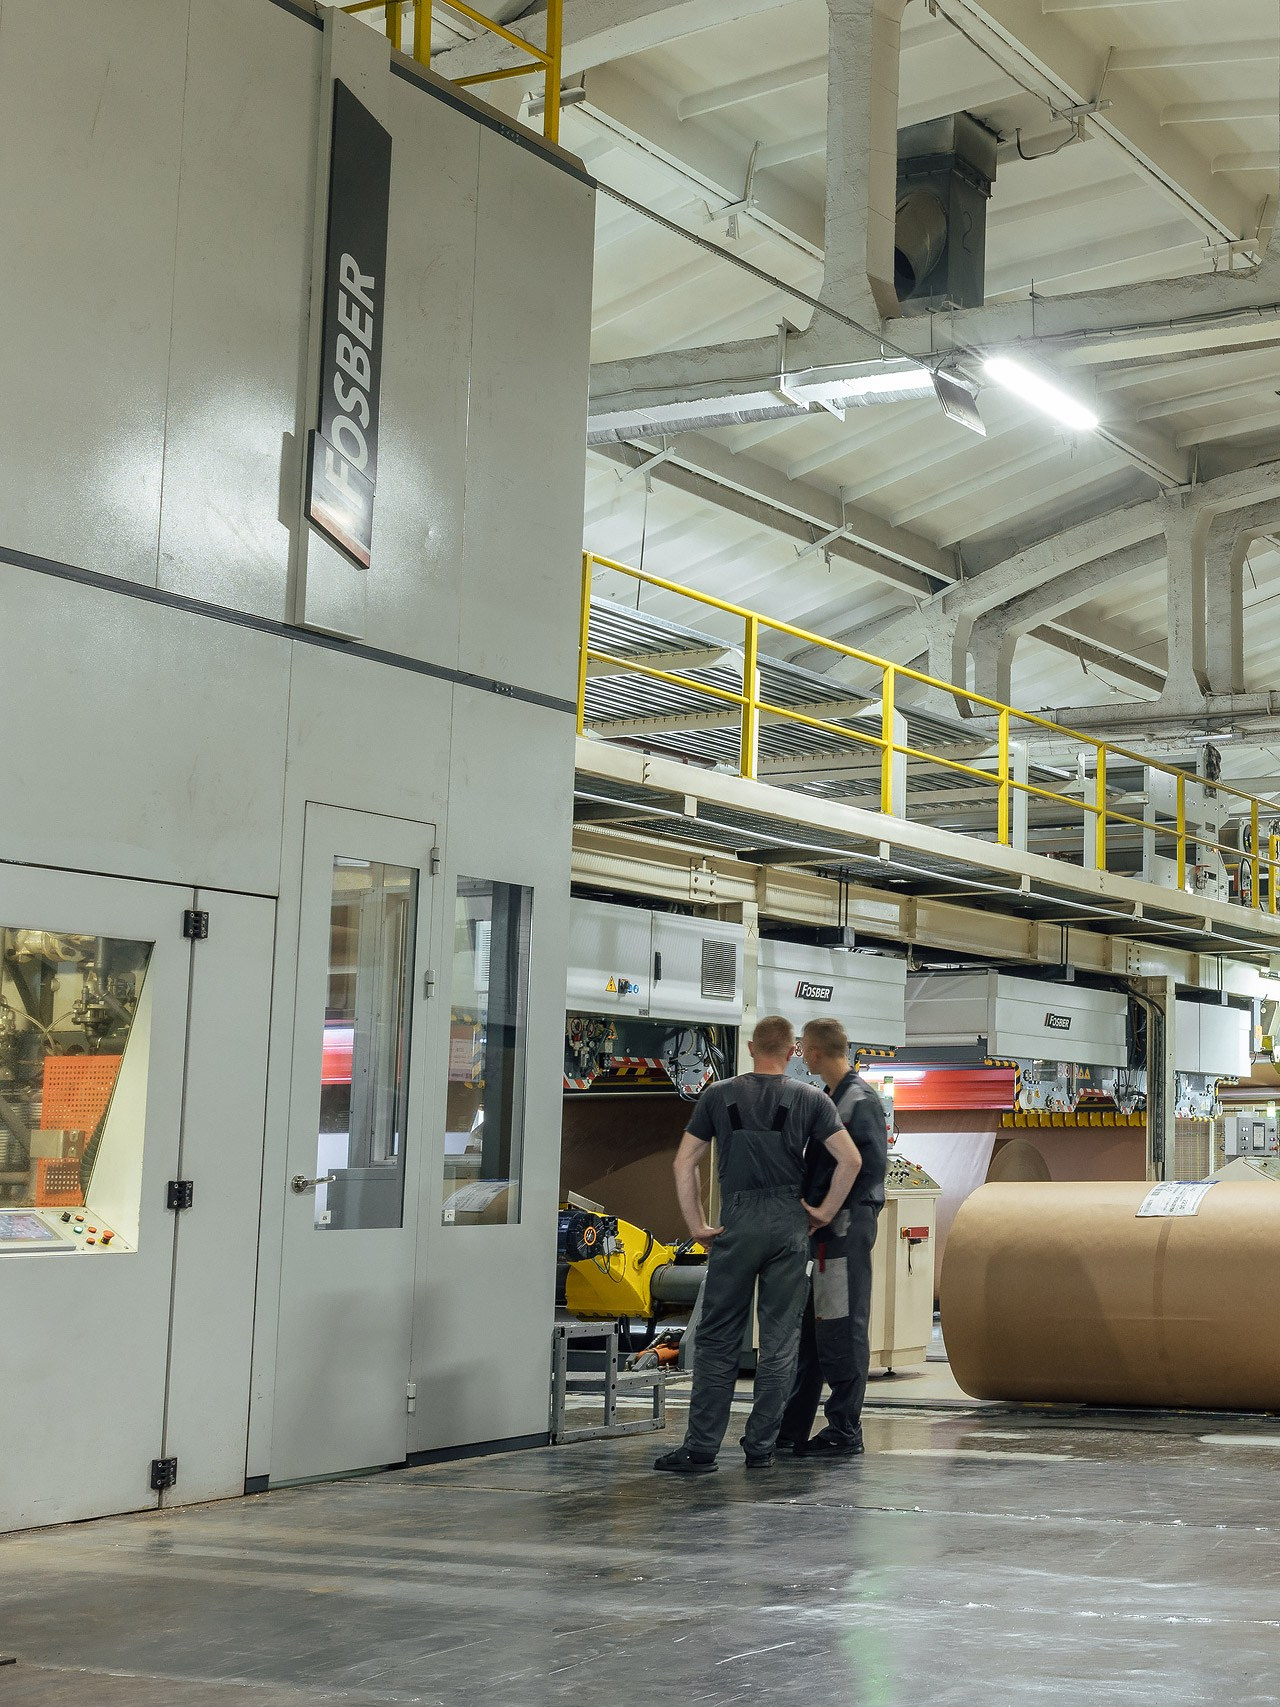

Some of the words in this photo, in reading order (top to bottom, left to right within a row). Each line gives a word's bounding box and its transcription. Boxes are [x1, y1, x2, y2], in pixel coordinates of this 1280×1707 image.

[325, 253, 376, 509] FOSBER
[801, 983, 831, 999] FOSBER
[1049, 1014, 1070, 1029] FOSBER
